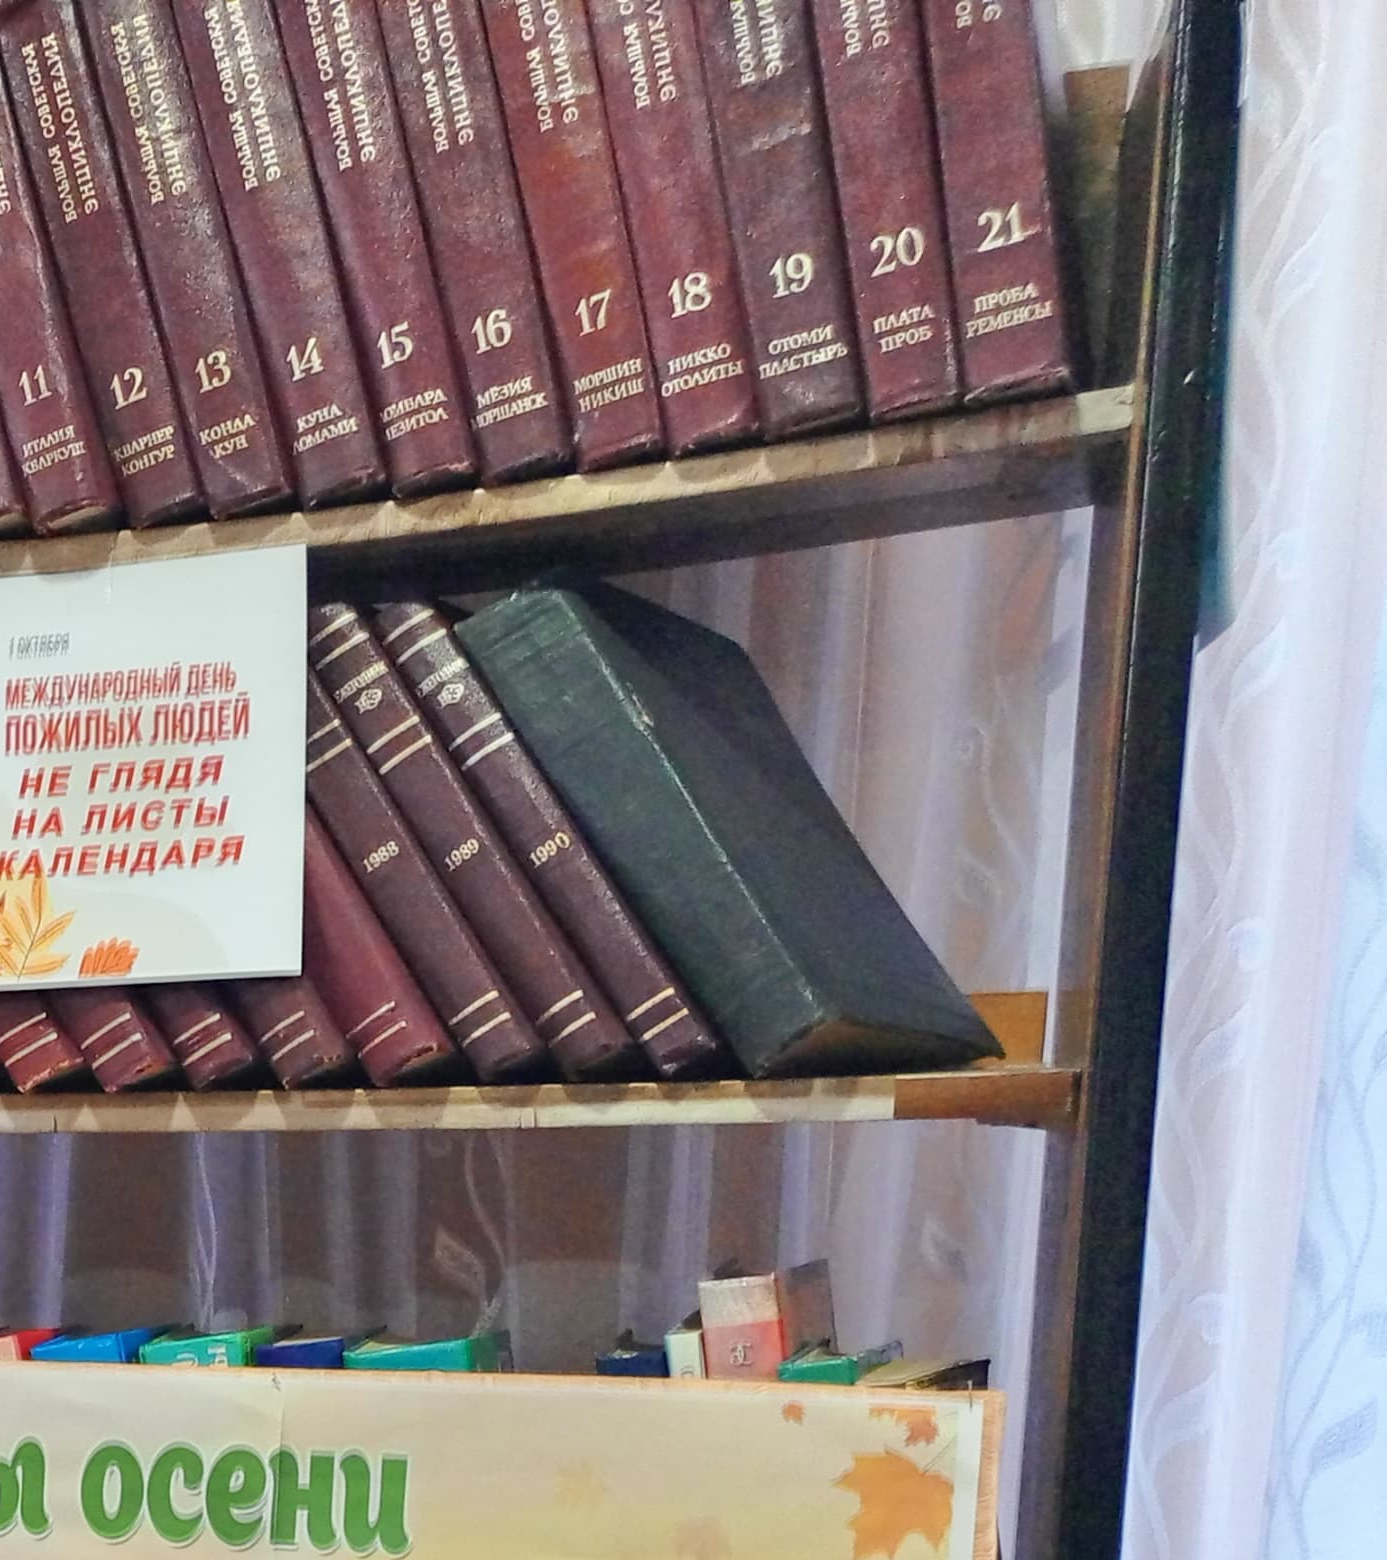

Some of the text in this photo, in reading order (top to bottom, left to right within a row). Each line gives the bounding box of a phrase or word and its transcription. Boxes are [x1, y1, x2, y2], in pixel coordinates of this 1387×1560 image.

[977, 202, 1029, 253] 21
[870, 227, 924, 277] 20
[668, 272, 711, 318] 18
[768, 253, 813, 299] 19
[575, 289, 611, 336] 17
[873, 304, 936, 334] ПЛАТА
[974, 282, 1039, 314] ПРОБА
[470, 309, 511, 354] 16
[768, 325, 835, 356] ОТОМИ
[879, 325, 933, 354] ПРОБ
[965, 300, 1053, 339] РЕМЕНСЫ
[286, 337, 324, 382] 14
[377, 322, 414, 369] 15
[667, 343, 731, 375] НИККО
[758, 342, 847, 380] ПЛАСТЫРЬ
[19, 364, 52, 406] 11
[110, 367, 147, 410] 12
[195, 350, 231, 394] 13
[574, 358, 642, 395] МОРШИН
[661, 360, 744, 398] ОТОЛИТЫ
[578, 378, 645, 412] НИКИШ
[296, 404, 343, 433] КУНА
[17, 633, 69, 659] ОКТЯБРЯ
[5, 662, 237, 710] МЕЖДУНАРОДНЫЙ ДЕНЬ
[5, 691, 250, 756] ПОЖИЛЫХ ЛЮДЕЙ
[19, 755, 224, 799] НЕ ГЛЯДЯ
[12, 795, 229, 840] НА ЛИСТЫ
[363, 840, 399, 874] 1988
[444, 838, 479, 872] 1989
[529, 832, 571, 868] 1990
[81, 1441, 410, 1556] осени
